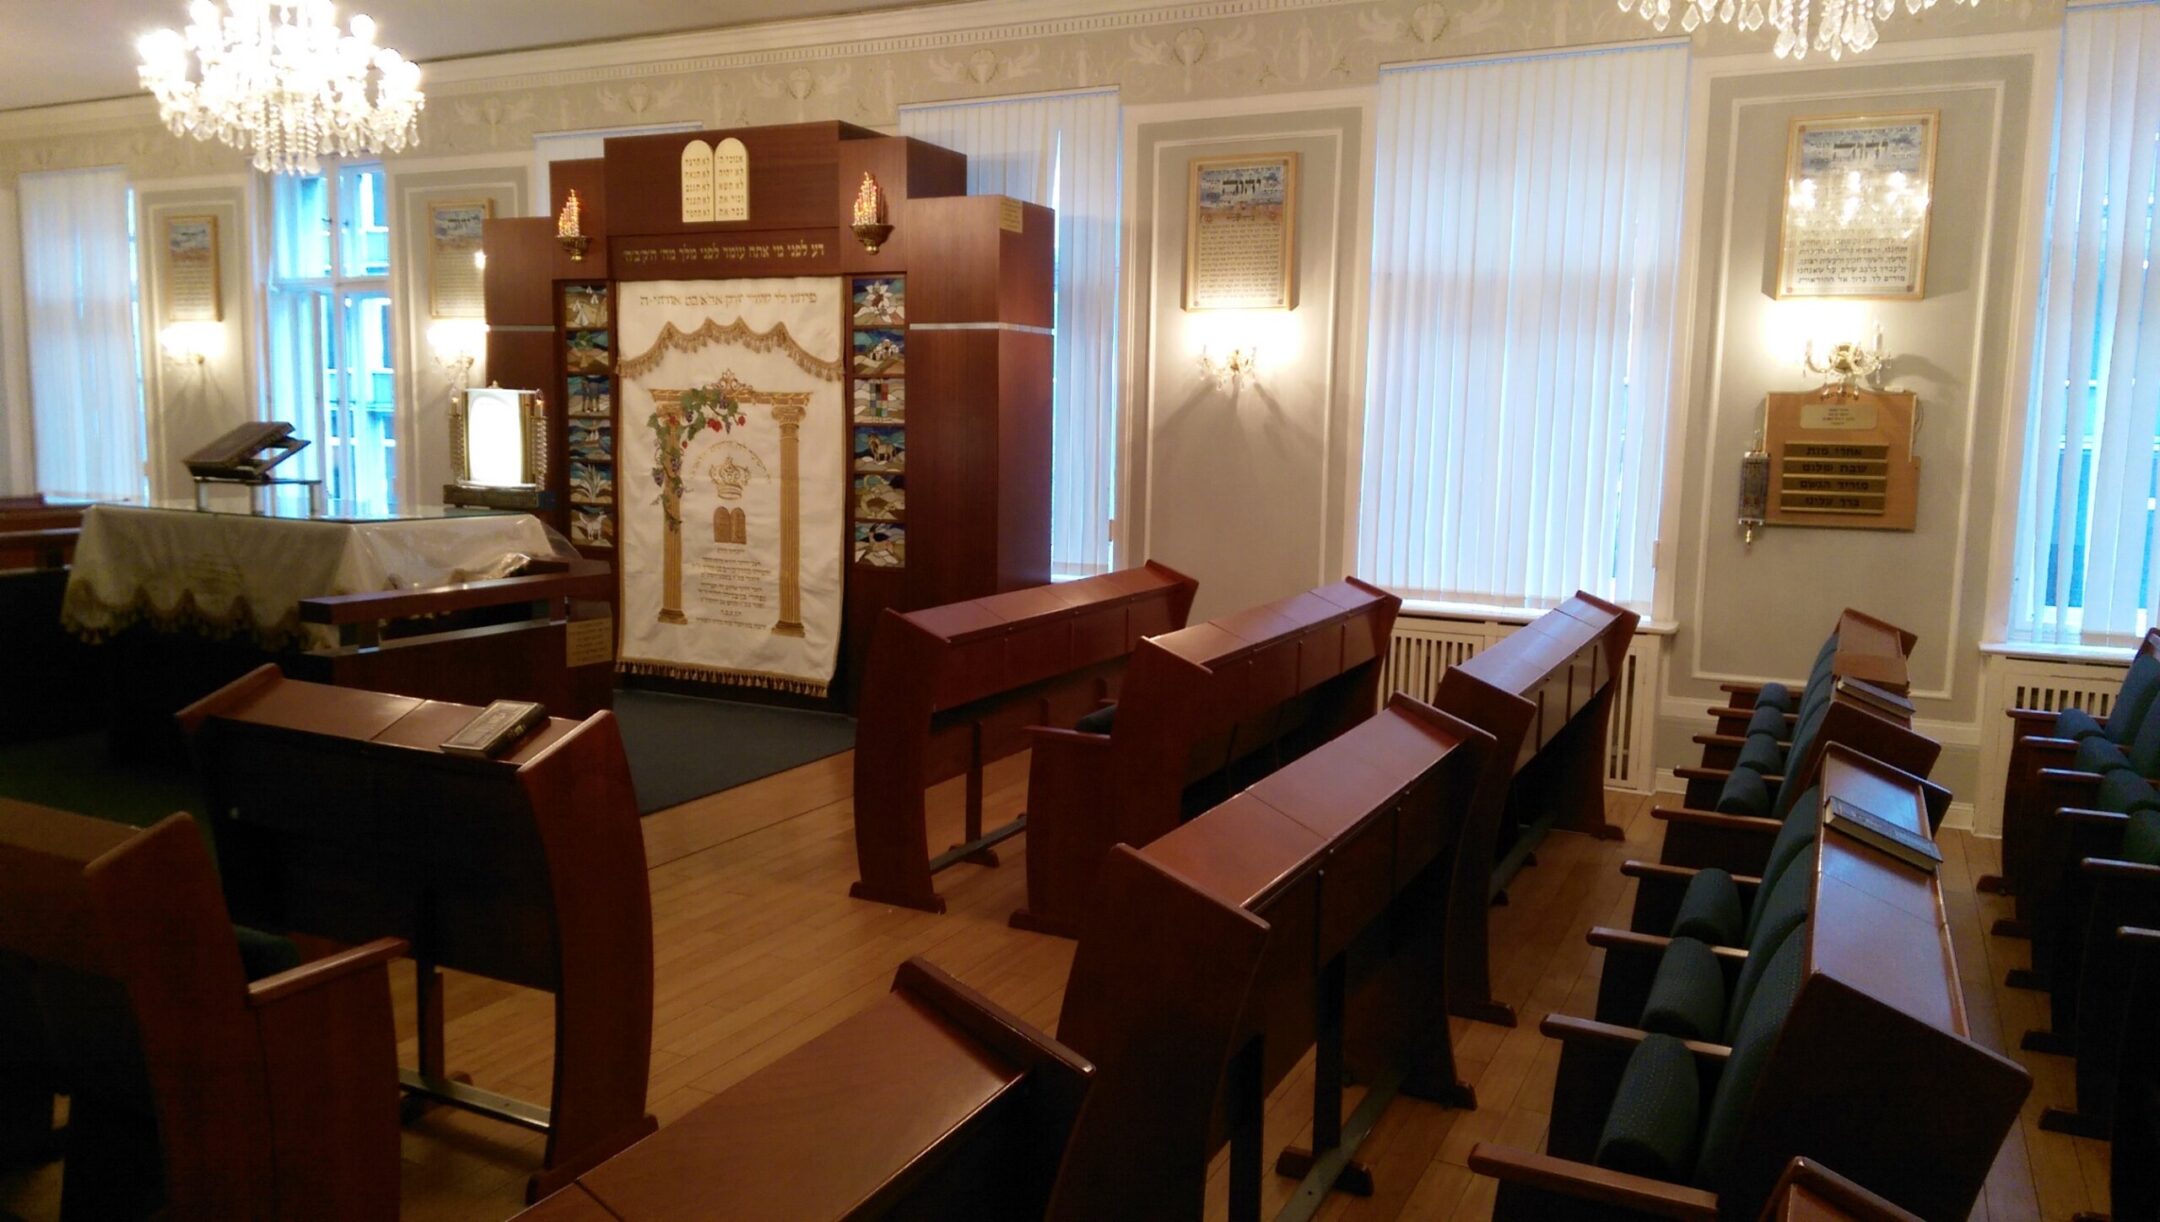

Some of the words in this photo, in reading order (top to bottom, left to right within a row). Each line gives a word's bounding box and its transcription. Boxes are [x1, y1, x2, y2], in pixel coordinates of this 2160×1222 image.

[1222, 178, 1262, 196] יהוה
[679, 243, 697, 262] מלך
[700, 241, 719, 260] לפני
[723, 245, 745, 260] עומד
[748, 244, 769, 258] אתה
[773, 243, 784, 258] מי
[787, 239, 807, 257] לפני
[811, 243, 824, 259] דע
[1806, 447, 1830, 456] מות
[1834, 447, 1864, 457] אחרי
[1802, 462, 1834, 473] שלום
[1839, 464, 1868, 474] שבת
[1800, 480, 1831, 490] הגשם
[1837, 481, 1869, 491] מוריד
[1805, 497, 1834, 507] עלינו
[1839, 498, 1860, 508] ברך
